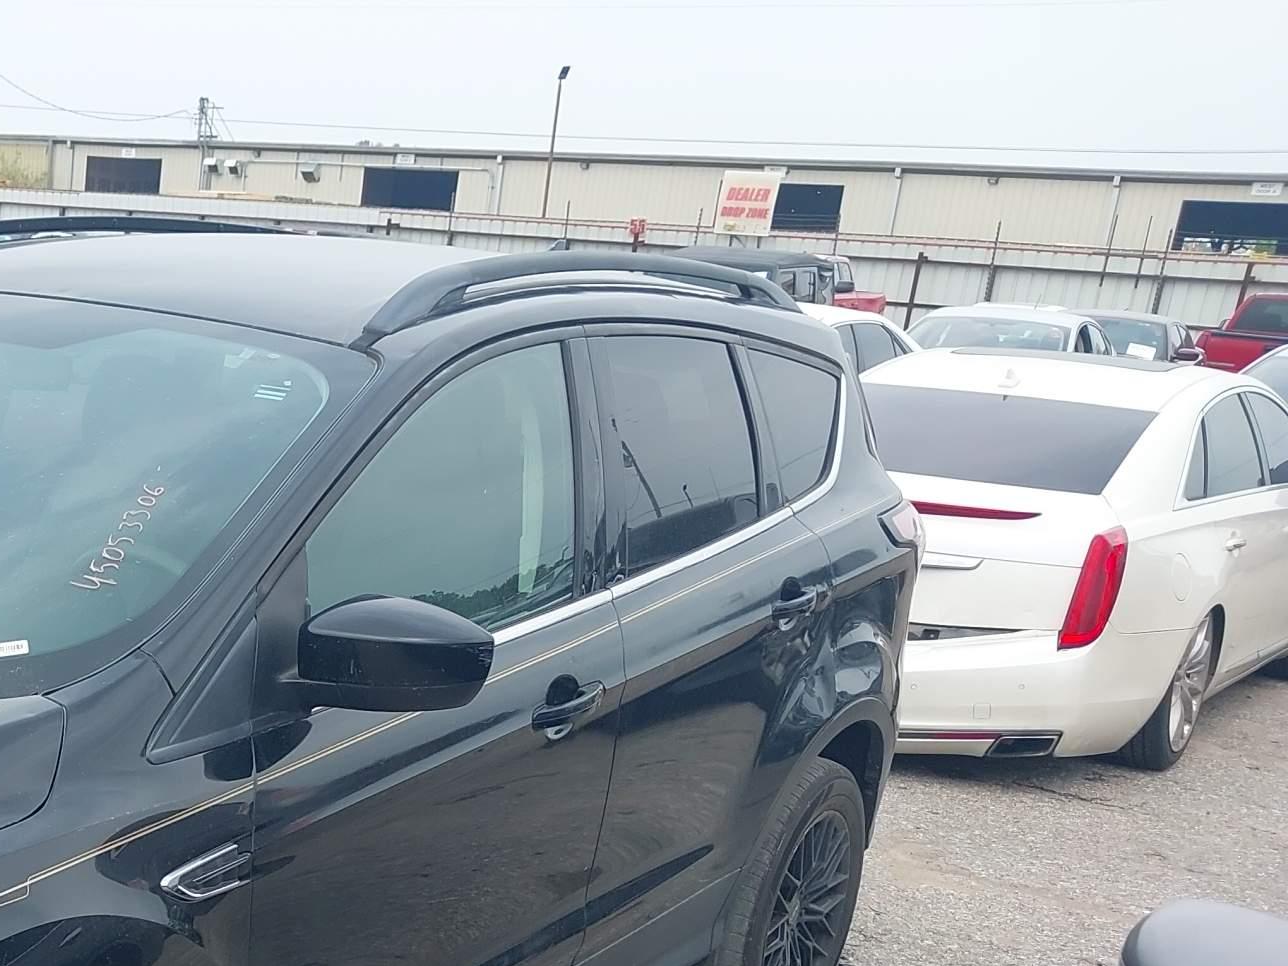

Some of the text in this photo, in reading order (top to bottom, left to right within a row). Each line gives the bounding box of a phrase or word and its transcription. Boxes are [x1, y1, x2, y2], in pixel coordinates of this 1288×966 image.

[726, 187, 772, 202] DEALER
[720, 206, 770, 219] DROP ZONE
[69, 483, 165, 591] 45053306
